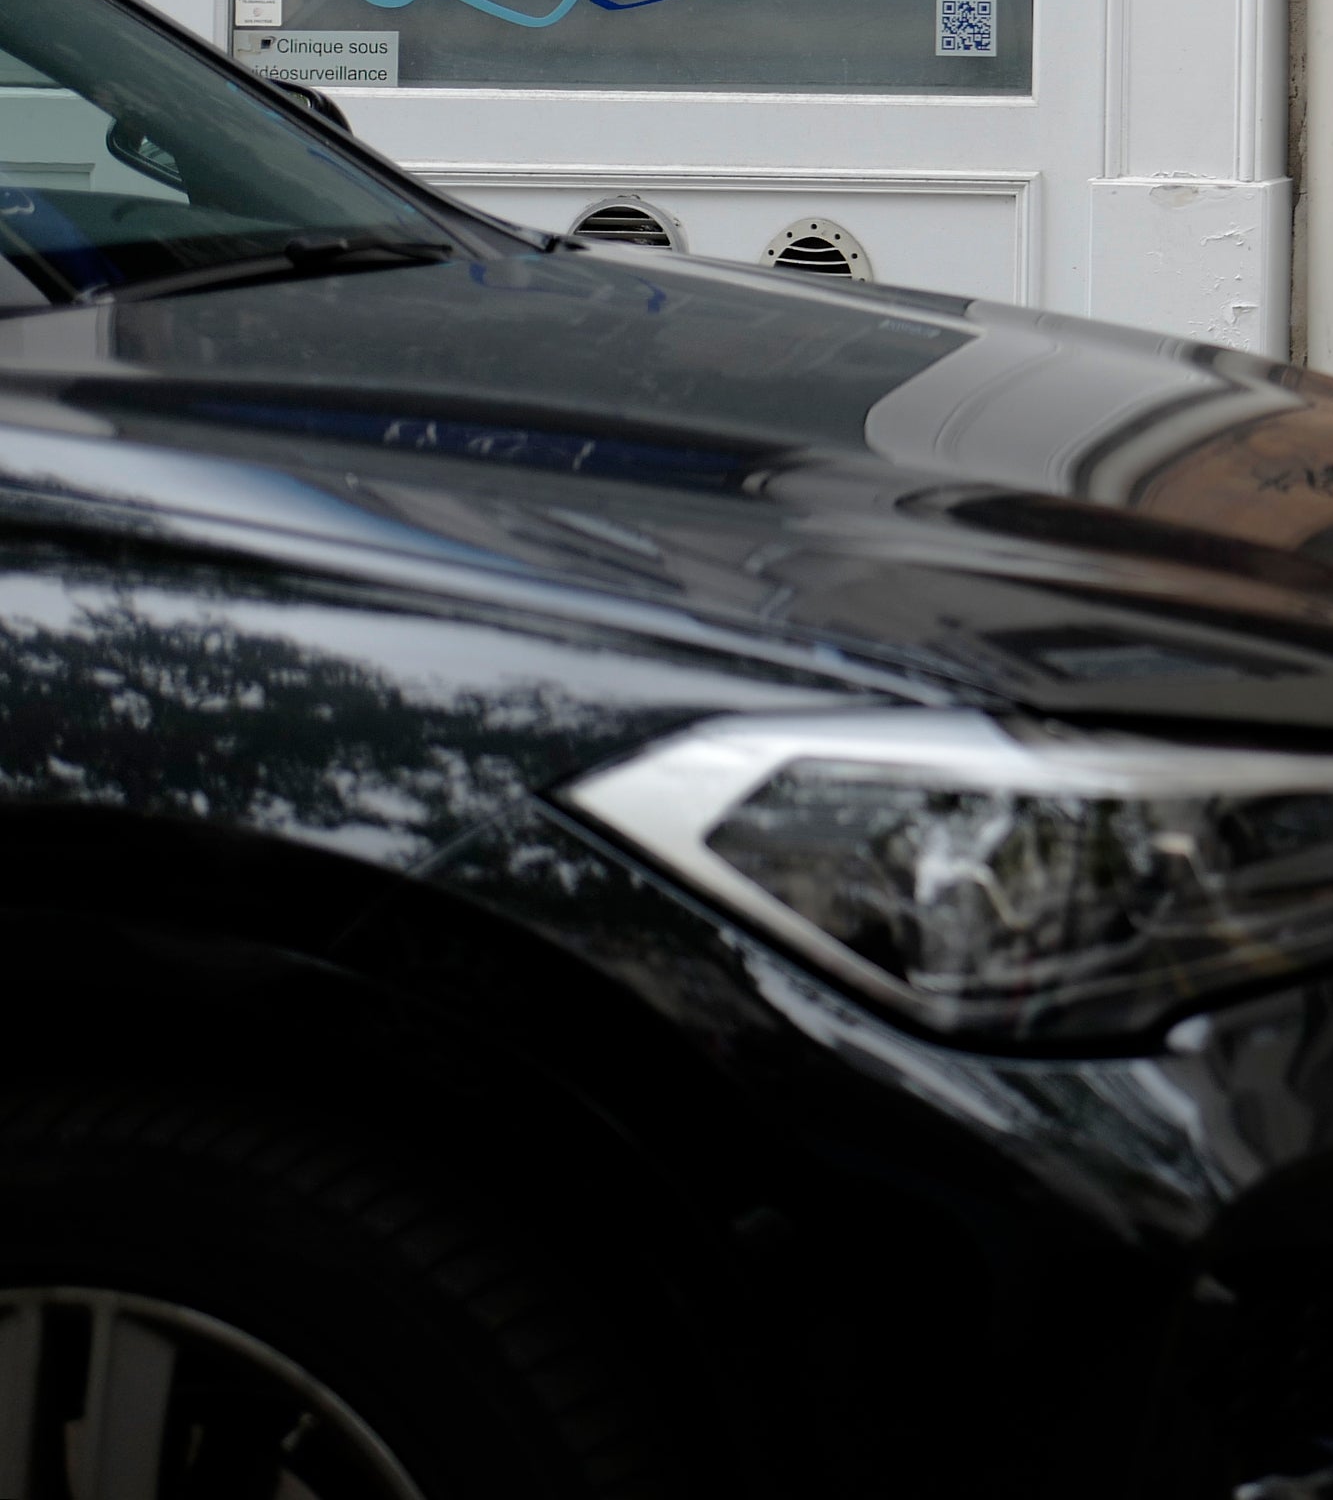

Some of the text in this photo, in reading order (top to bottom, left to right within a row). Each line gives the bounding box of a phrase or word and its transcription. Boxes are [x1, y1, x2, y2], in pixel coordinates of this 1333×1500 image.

[276, 38, 388, 56] Clinique sous
[252, 65, 388, 81] idéosurveillance
